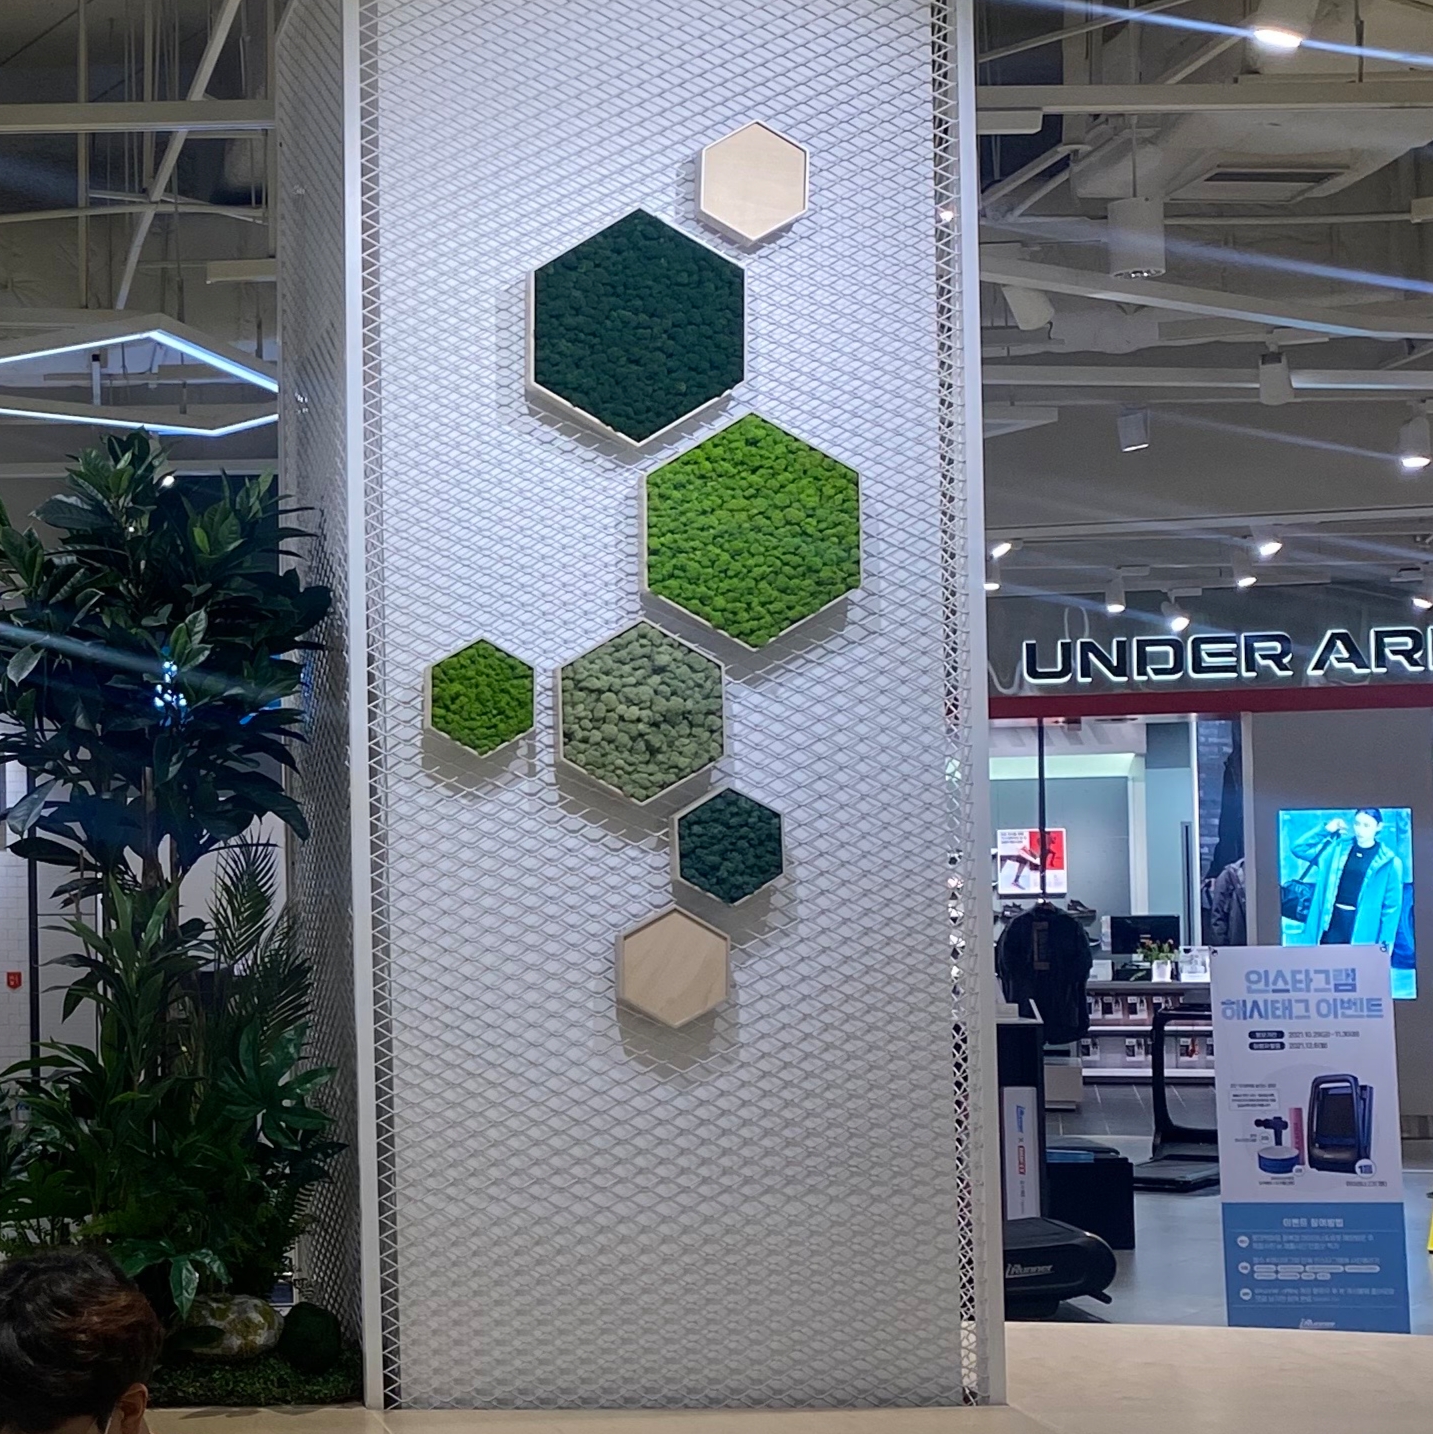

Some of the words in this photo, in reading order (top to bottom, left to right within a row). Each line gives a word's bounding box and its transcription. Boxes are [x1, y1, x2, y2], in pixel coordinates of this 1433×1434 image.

[1022, 631, 1294, 684] UNDER
[1307, 626, 1433, 677] AR
[1244, 967, 1357, 994] 인스타그램
[1221, 998, 1311, 1020] 해시태그
[1316, 997, 1384, 1019] 이벤트
